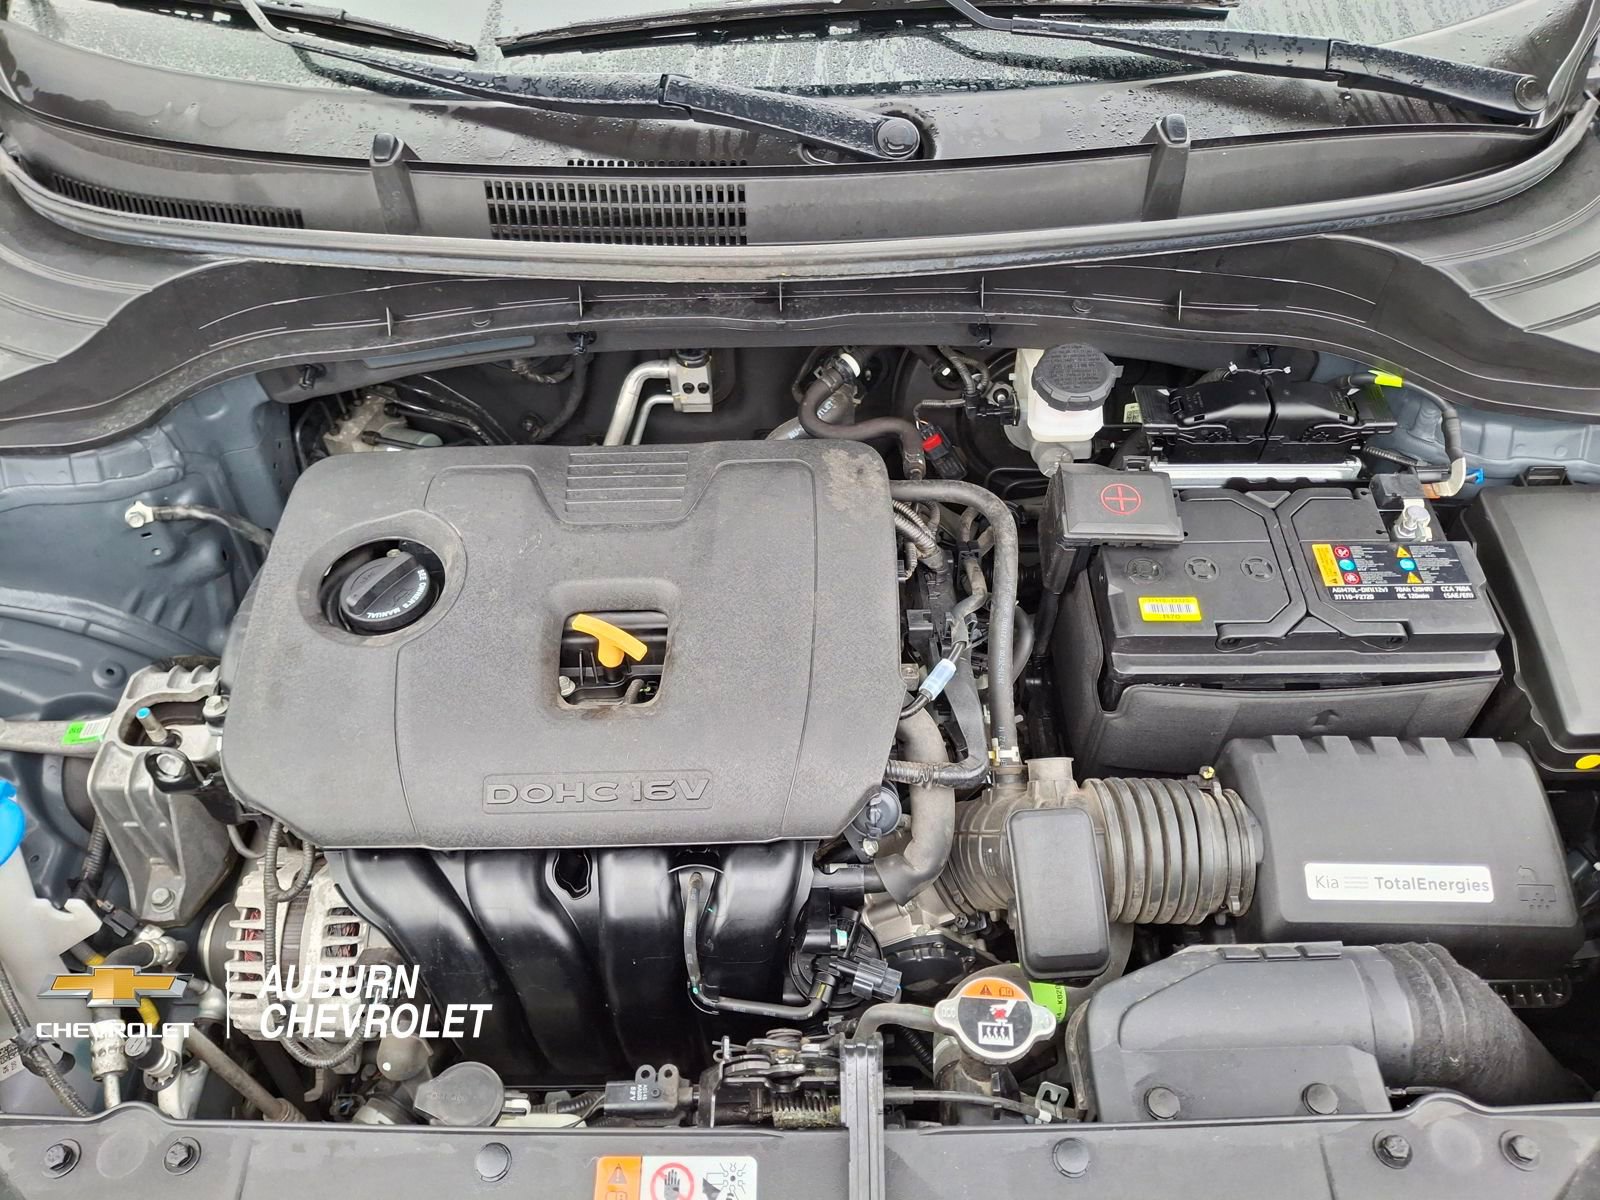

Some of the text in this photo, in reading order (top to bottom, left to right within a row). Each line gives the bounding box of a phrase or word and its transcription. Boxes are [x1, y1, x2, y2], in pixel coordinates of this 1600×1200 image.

[417, 568, 427, 581] SEE
[366, 606, 401, 619] MANUAL
[487, 778, 710, 804] DOHC 16V
[1315, 875, 1490, 894] Kia TotalEnergies
